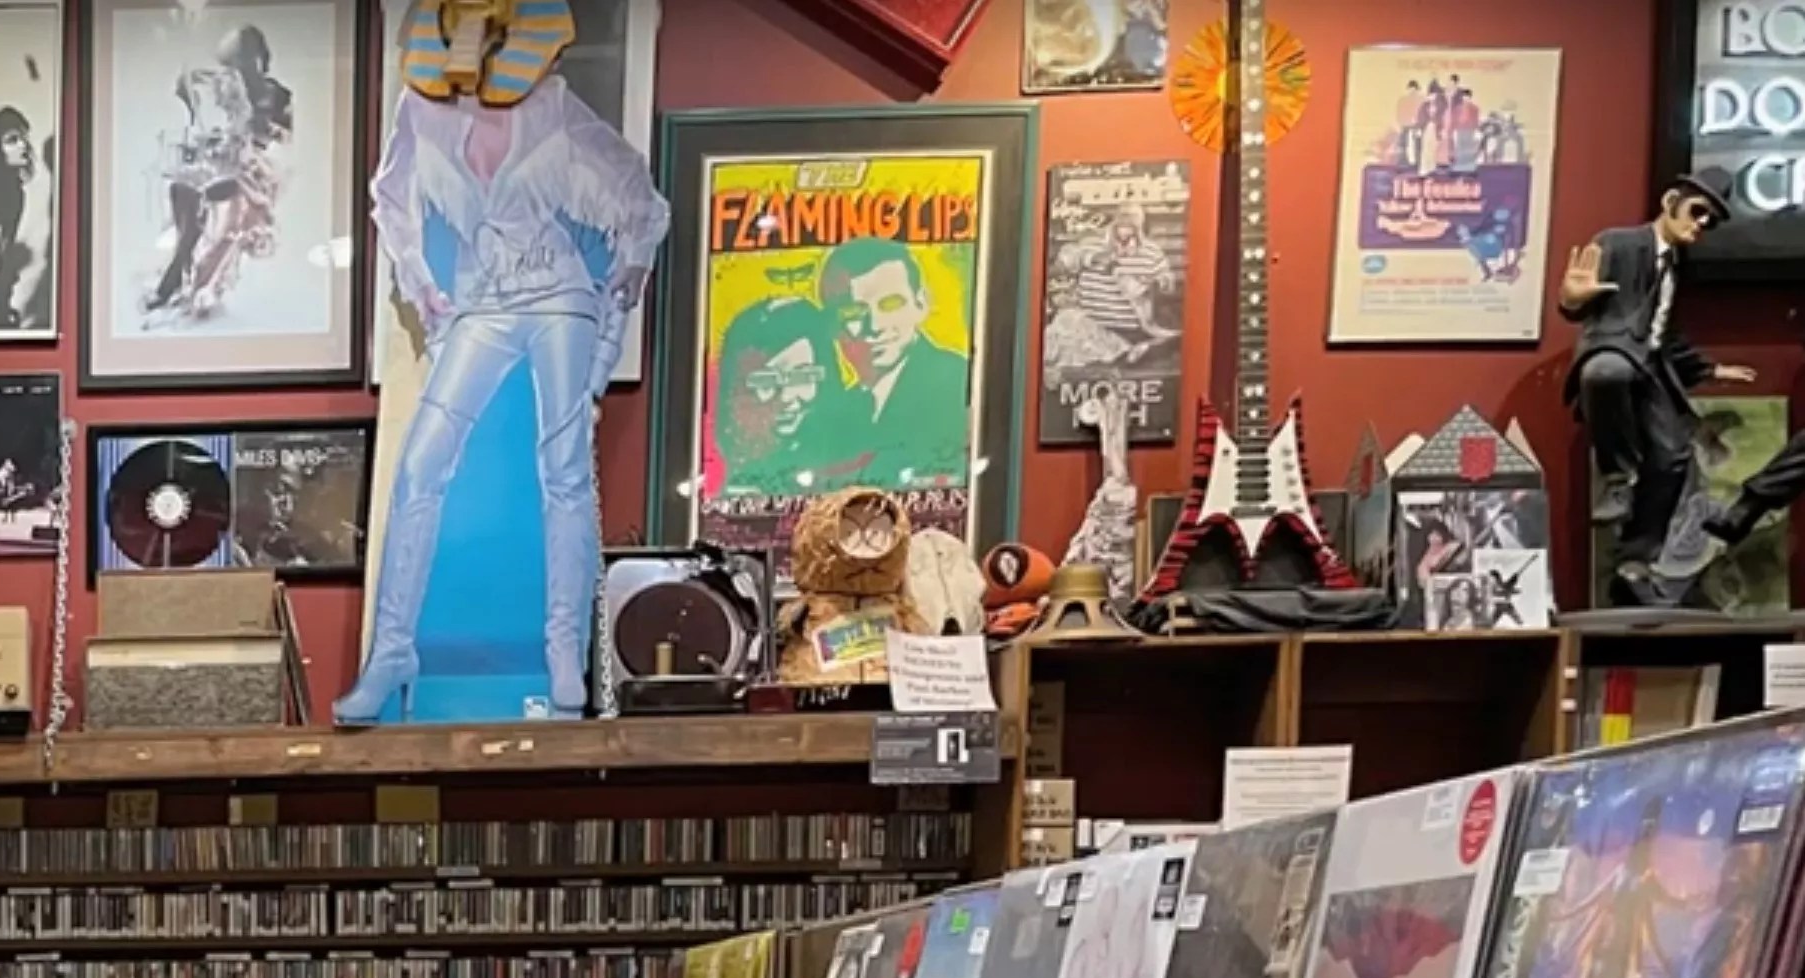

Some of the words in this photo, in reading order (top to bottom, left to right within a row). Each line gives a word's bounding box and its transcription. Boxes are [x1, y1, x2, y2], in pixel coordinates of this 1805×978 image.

[1737, 154, 1805, 212] C
[711, 184, 902, 252] FLAMING
[906, 190, 978, 242] LIPS
